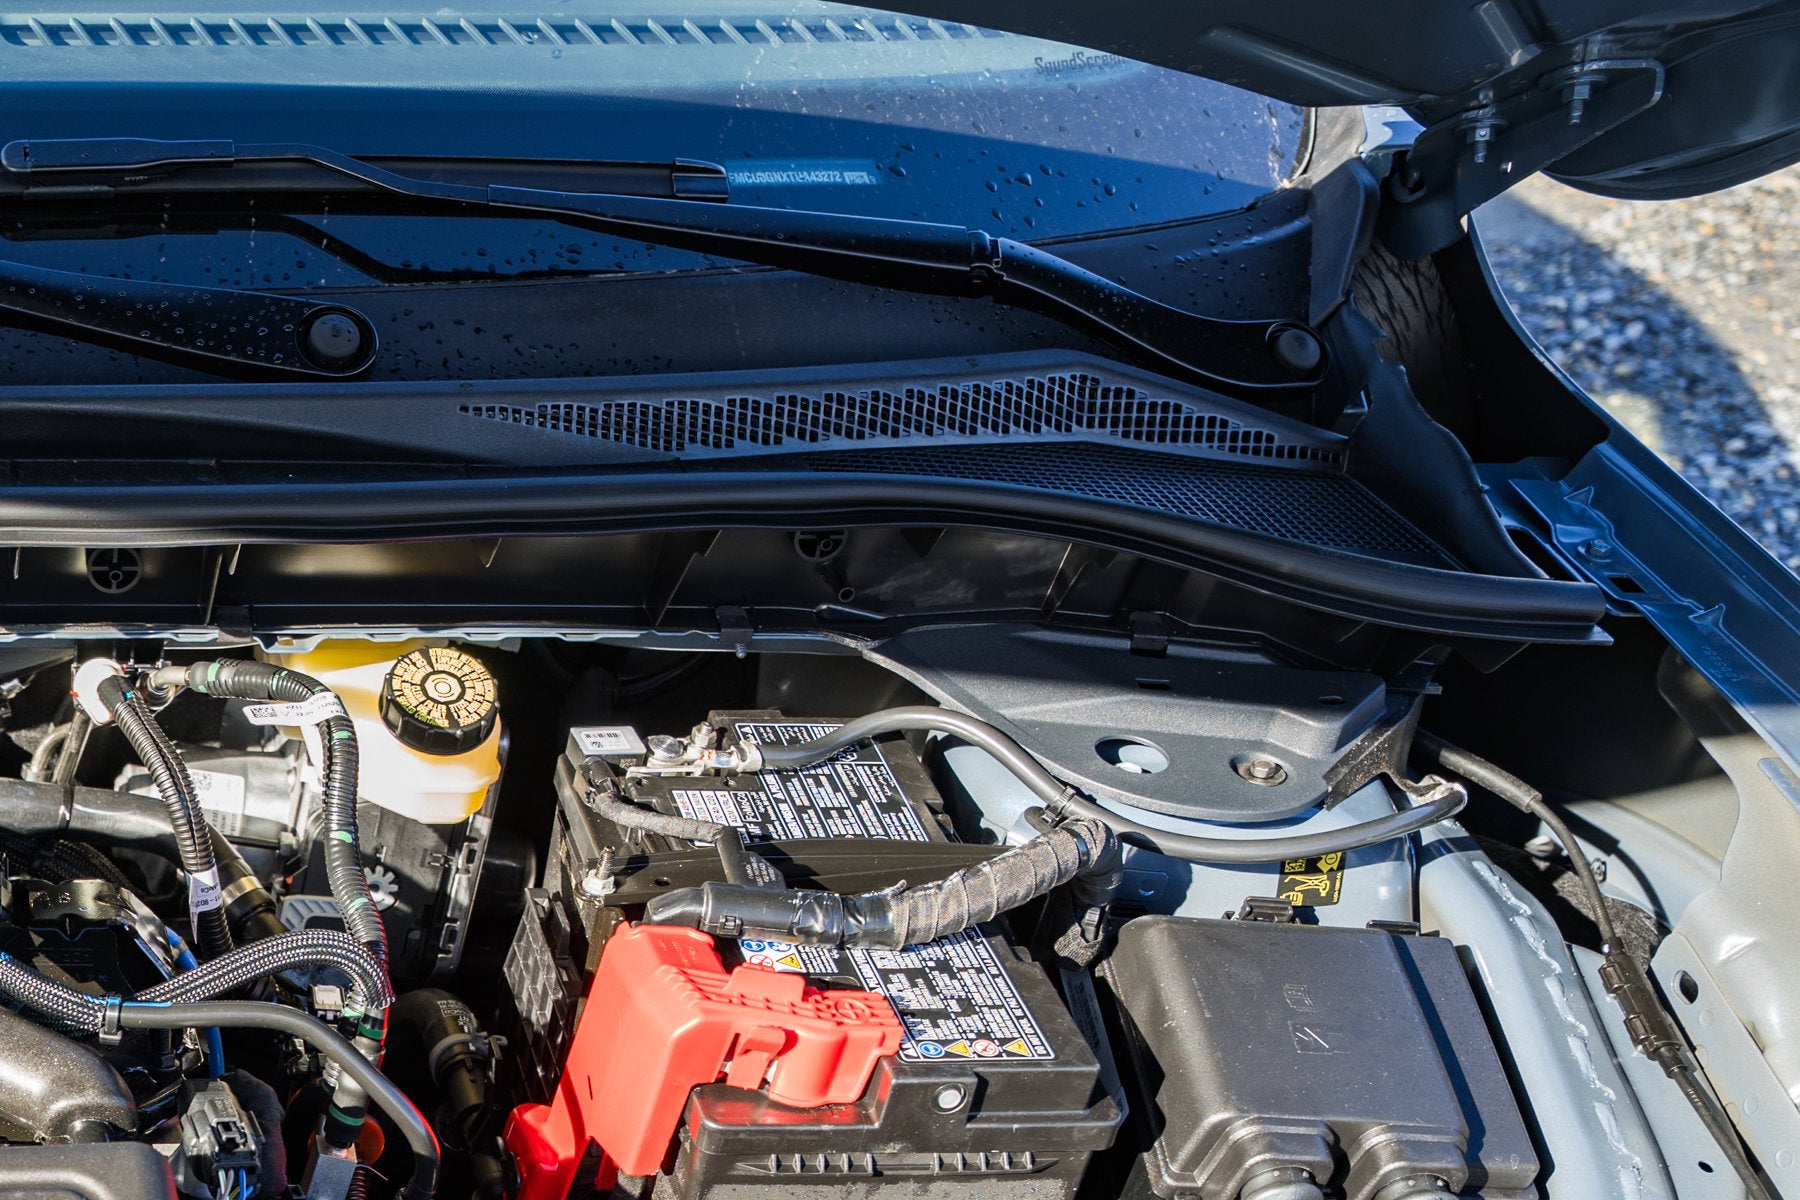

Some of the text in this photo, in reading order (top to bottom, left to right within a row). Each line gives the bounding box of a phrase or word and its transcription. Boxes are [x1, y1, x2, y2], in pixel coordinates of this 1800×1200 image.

[737, 792, 757, 821] FoMoCo
[1008, 998, 1019, 1006] PAS
[1029, 1034, 1041, 1044] NOT
